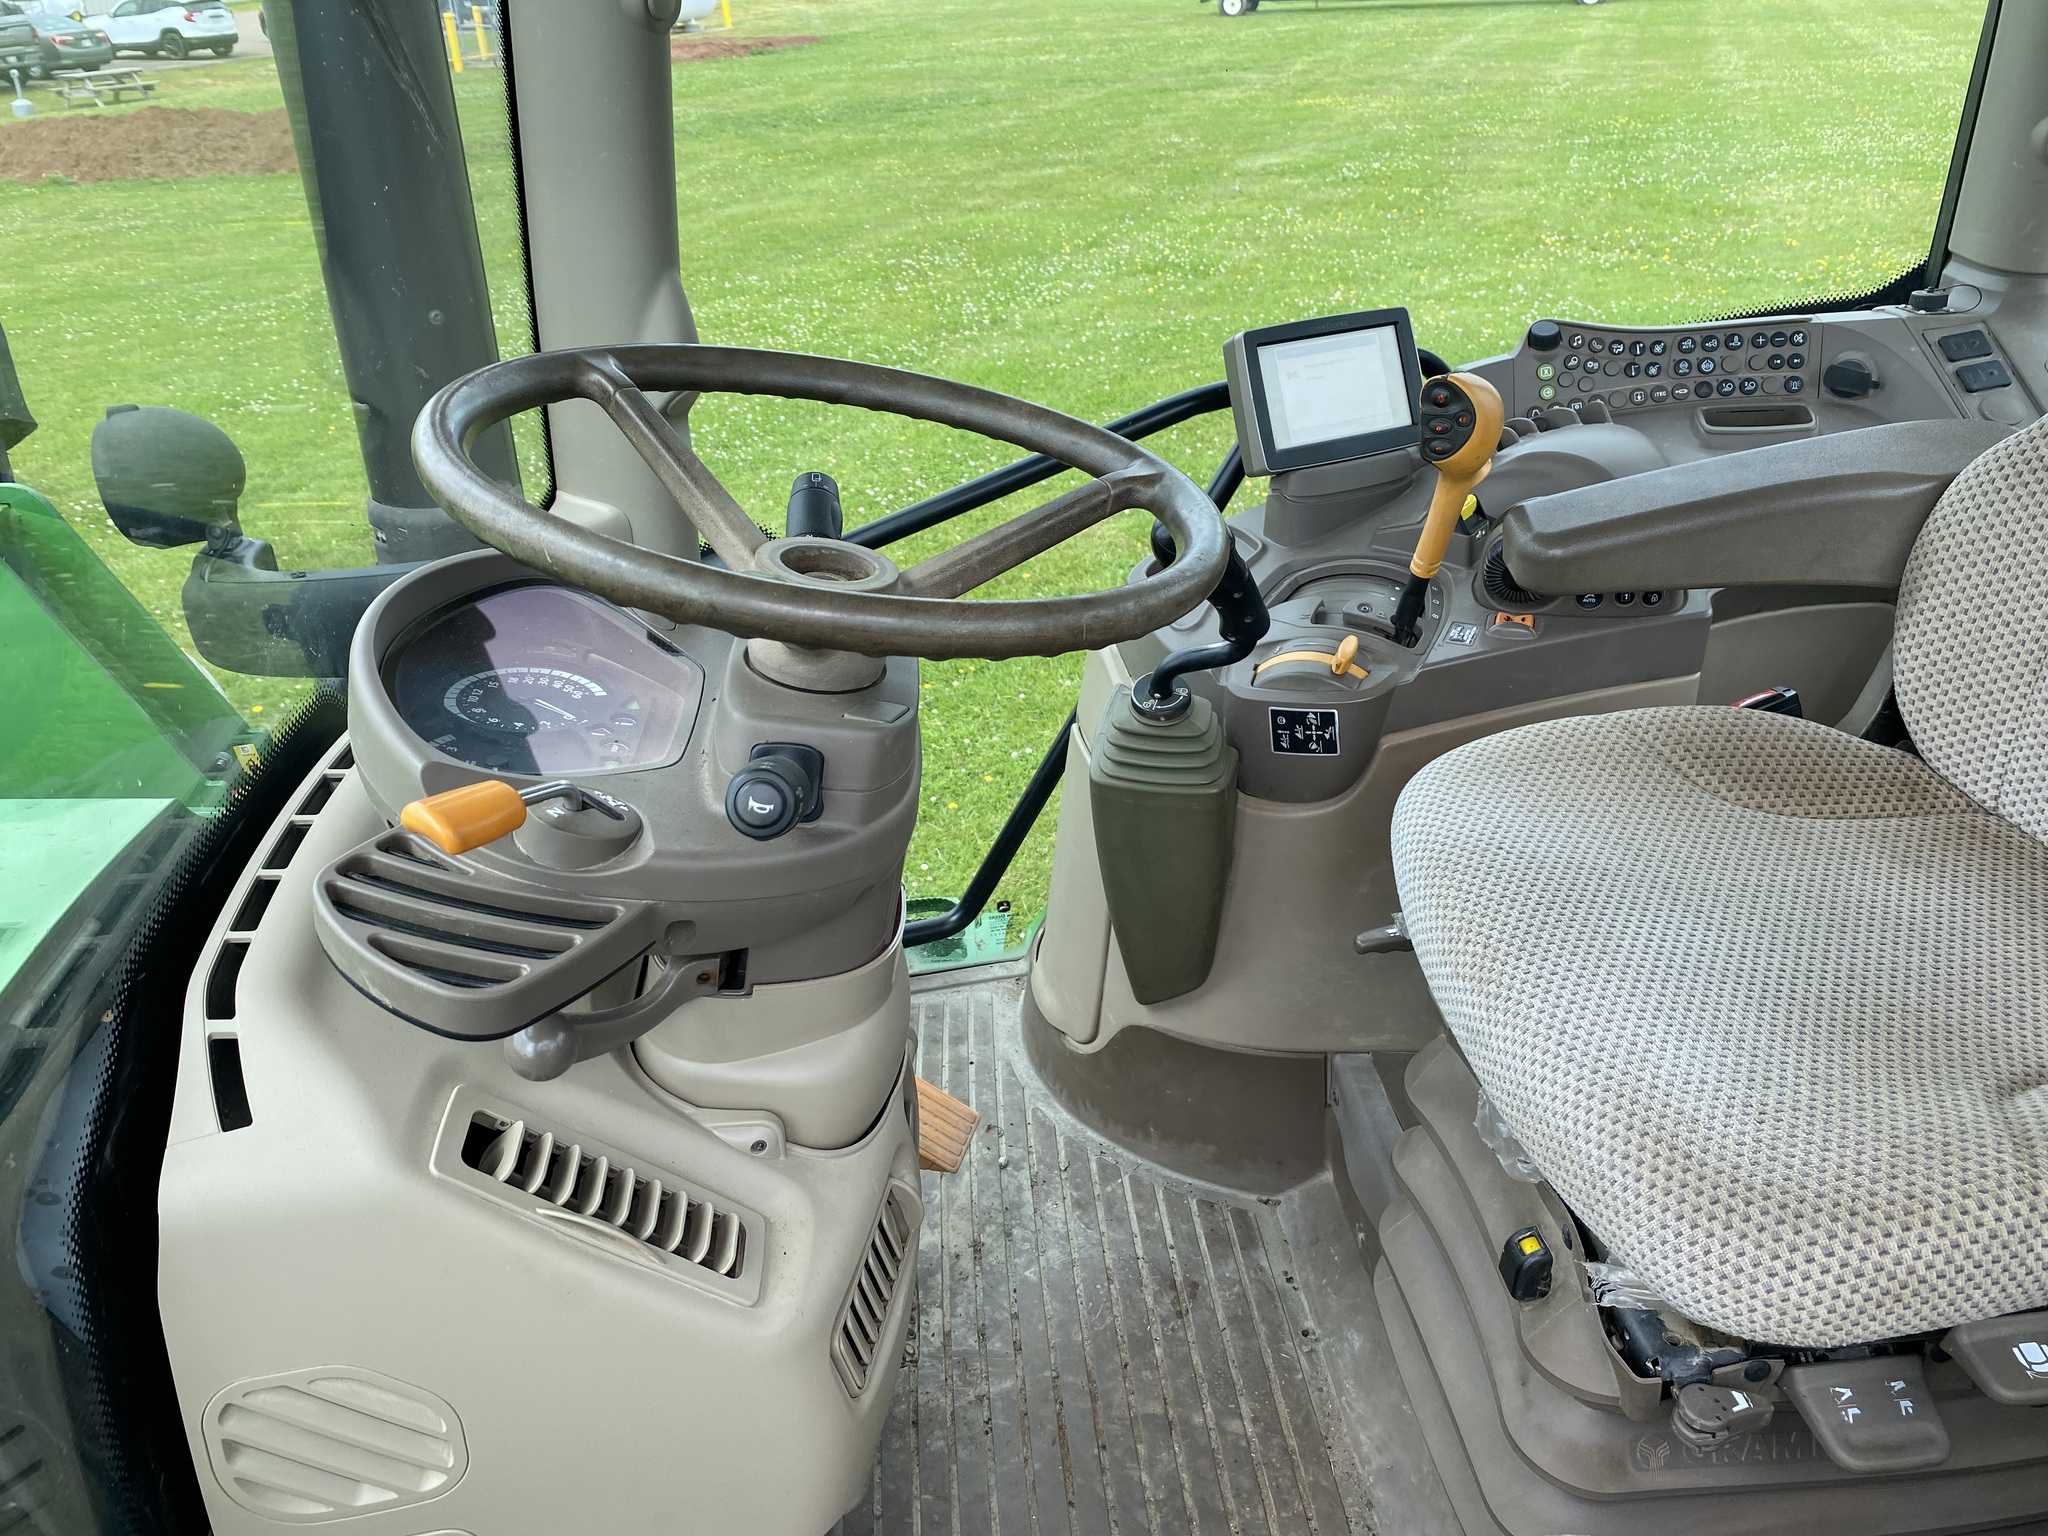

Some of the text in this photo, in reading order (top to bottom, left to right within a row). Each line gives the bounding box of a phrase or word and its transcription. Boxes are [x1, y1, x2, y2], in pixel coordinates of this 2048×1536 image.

[508, 676, 519, 684] 18
[523, 676, 534, 685] 20
[538, 677, 549, 686] 30
[467, 695, 479, 703] 10
[545, 806, 565, 818] N
